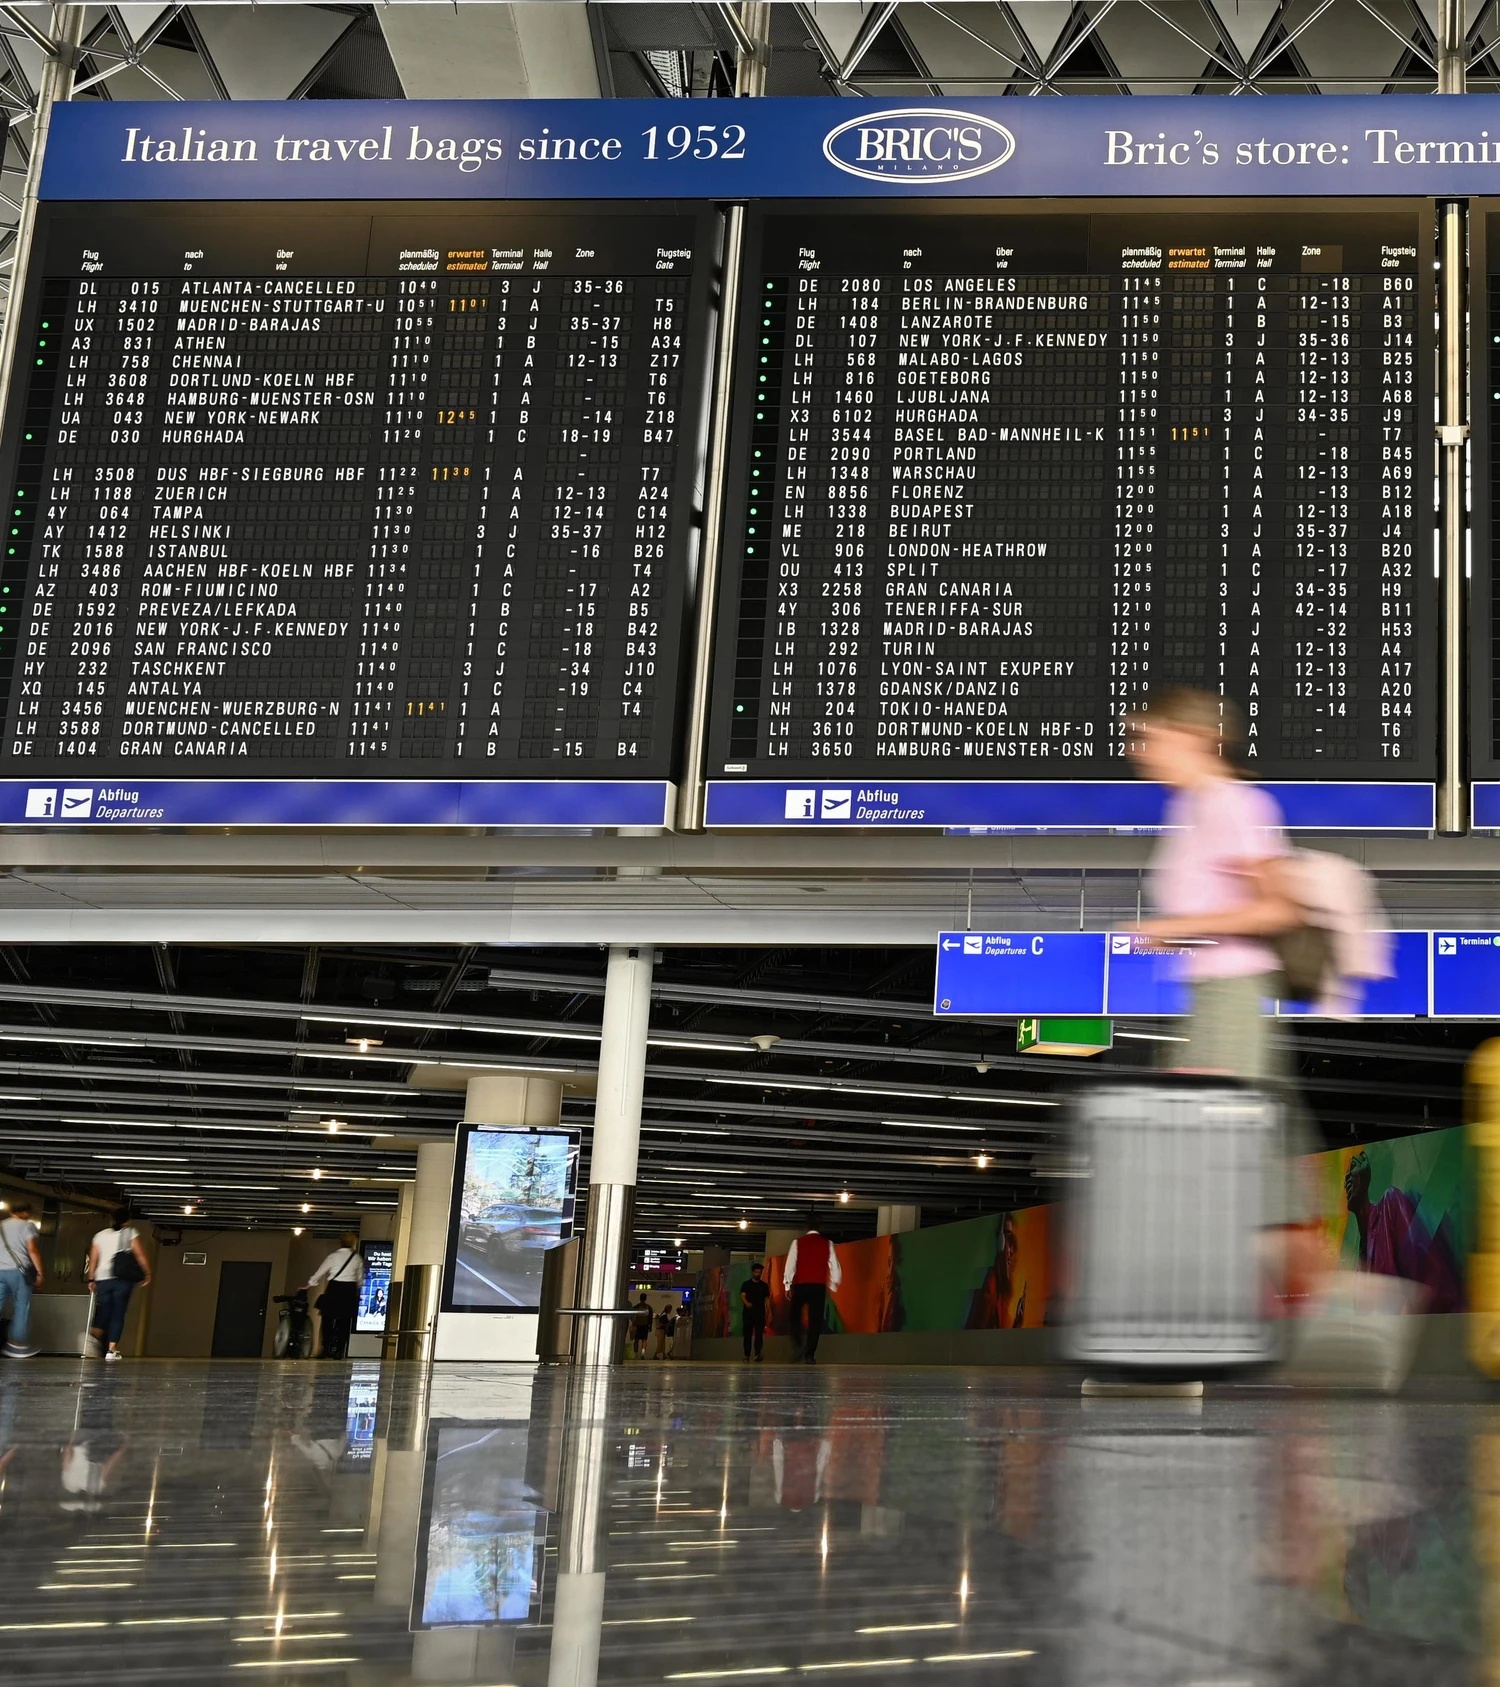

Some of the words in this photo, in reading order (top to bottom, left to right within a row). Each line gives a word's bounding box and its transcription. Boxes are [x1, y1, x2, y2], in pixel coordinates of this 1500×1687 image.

[121, 127, 258, 161] Italian
[274, 126, 392, 161] travel
[406, 126, 501, 172] bags
[519, 129, 621, 160] since
[642, 125, 745, 160] 1952
[856, 127, 981, 161] BRIC'S
[1237, 138, 1348, 164] store:
[83, 250, 99, 260] Flug
[185, 250, 203, 258] nach
[277, 250, 294, 258] über
[400, 249, 439, 260] planmäßig
[492, 249, 523, 257] Terminal
[534, 249, 552, 257] Halle
[576, 249, 594, 257] Zone
[657, 249, 691, 259] Flugsteig
[81, 262, 103, 272] Flight
[399, 262, 438, 270] scheduled
[447, 262, 488, 270] estimated
[492, 261, 523, 270] Terminal
[533, 261, 548, 269] Hall
[656, 260, 673, 269] Gate
[797, 316, 815, 328] DE
[841, 316, 877, 328] 1408
[902, 316, 992, 328] LANZAROTE
[1384, 315, 1401, 327] B3
[70, 356, 88, 368] LH
[123, 355, 149, 368] 758
[173, 355, 240, 368] CHENNAI
[651, 355, 679, 367] Z17
[788, 467, 806, 479] LH
[832, 466, 868, 479] 1348
[893, 466, 975, 479] WARSCHAU
[1382, 466, 1411, 479] A69
[36, 584, 55, 596] AZ
[89, 584, 118, 596] 403
[142, 583, 277, 596] ROM-FIUMICINO
[631, 584, 649, 596] A2
[33, 603, 52, 616] DE
[78, 603, 115, 616] 1592
[139, 603, 296, 616] PREVEZA/LEFKADA
[630, 603, 648, 616] B5
[771, 702, 790, 715] NH
[826, 702, 854, 715] 204
[880, 702, 1007, 715] TOKIO-HANEDA
[1382, 703, 1411, 716] B44
[98, 789, 138, 803] Abflug
[857, 790, 898, 804] Abflug
[96, 806, 164, 820] Departures
[856, 807, 924, 821] Departures
[985, 936, 1011, 947] Abflug
[1031, 936, 1044, 955] C
[1460, 937, 1491, 945] Terminal
[984, 946, 1027, 957] Departures
[1133, 947, 1175, 956] Departures
